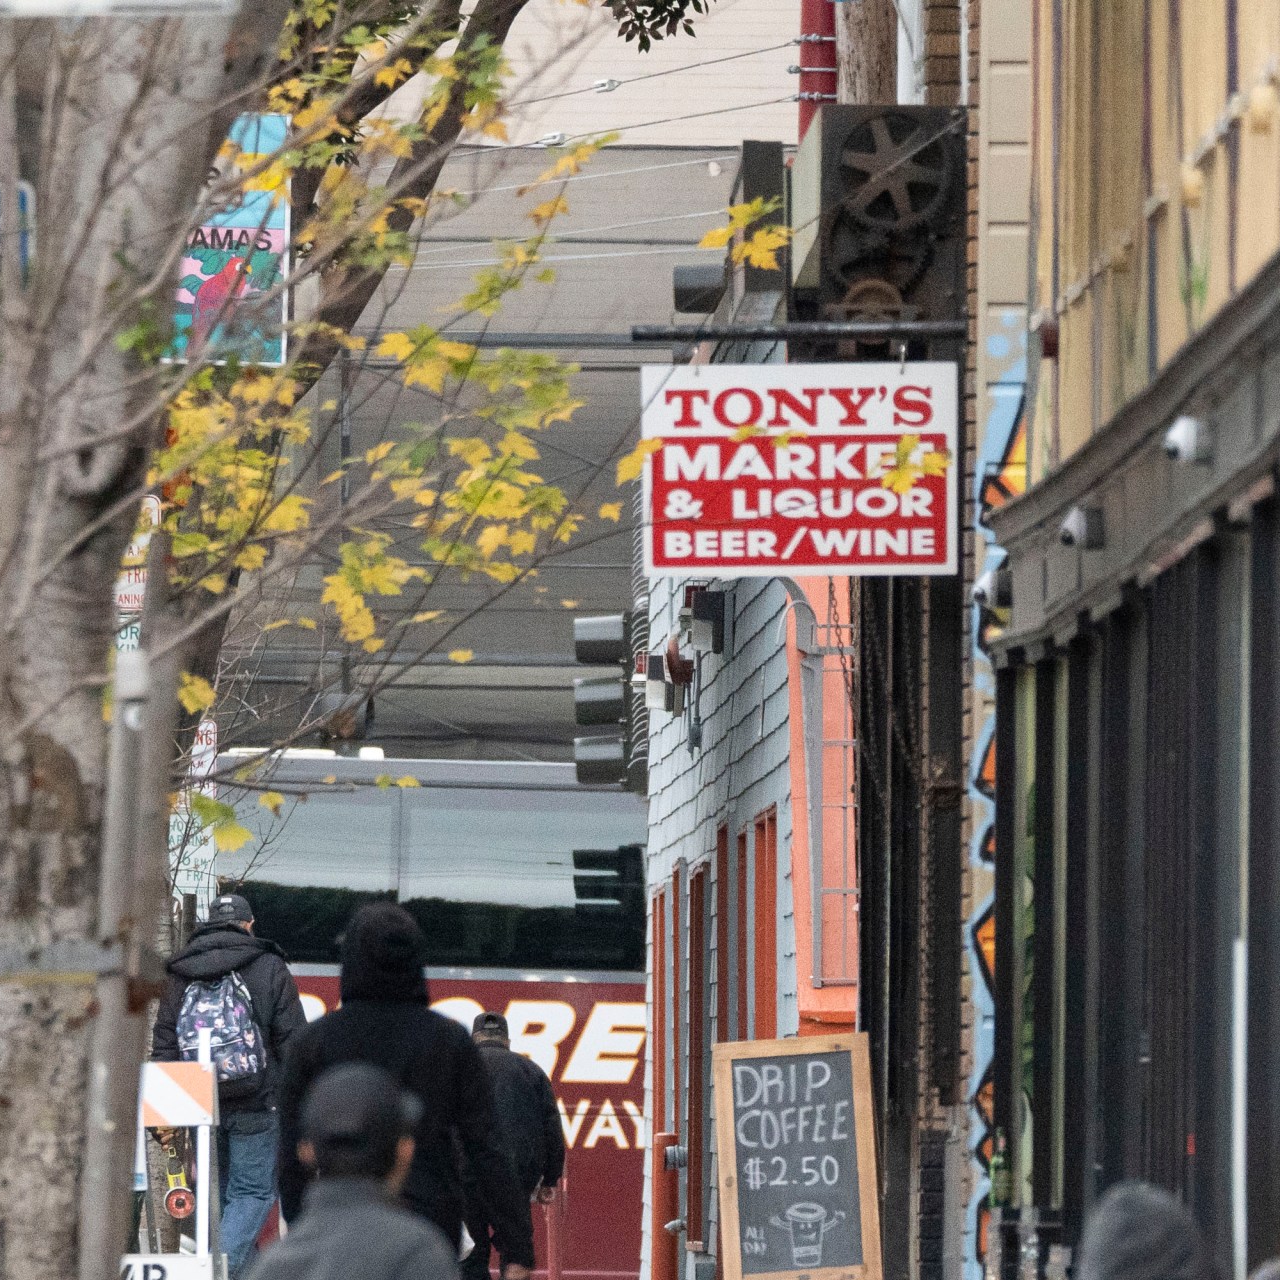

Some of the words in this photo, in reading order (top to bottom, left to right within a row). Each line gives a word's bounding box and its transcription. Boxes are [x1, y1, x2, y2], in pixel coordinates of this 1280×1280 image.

[665, 385, 933, 429] TONY'S
[664, 488, 703, 519] &
[731, 488, 934, 519] LIQUOR
[663, 526, 936, 560] BEER/WINE
[186, 871, 203, 881] FRI
[734, 1061, 831, 1108] DRIP
[736, 1101, 849, 1149] COFFEE
[743, 1155, 840, 1190] $2.50
